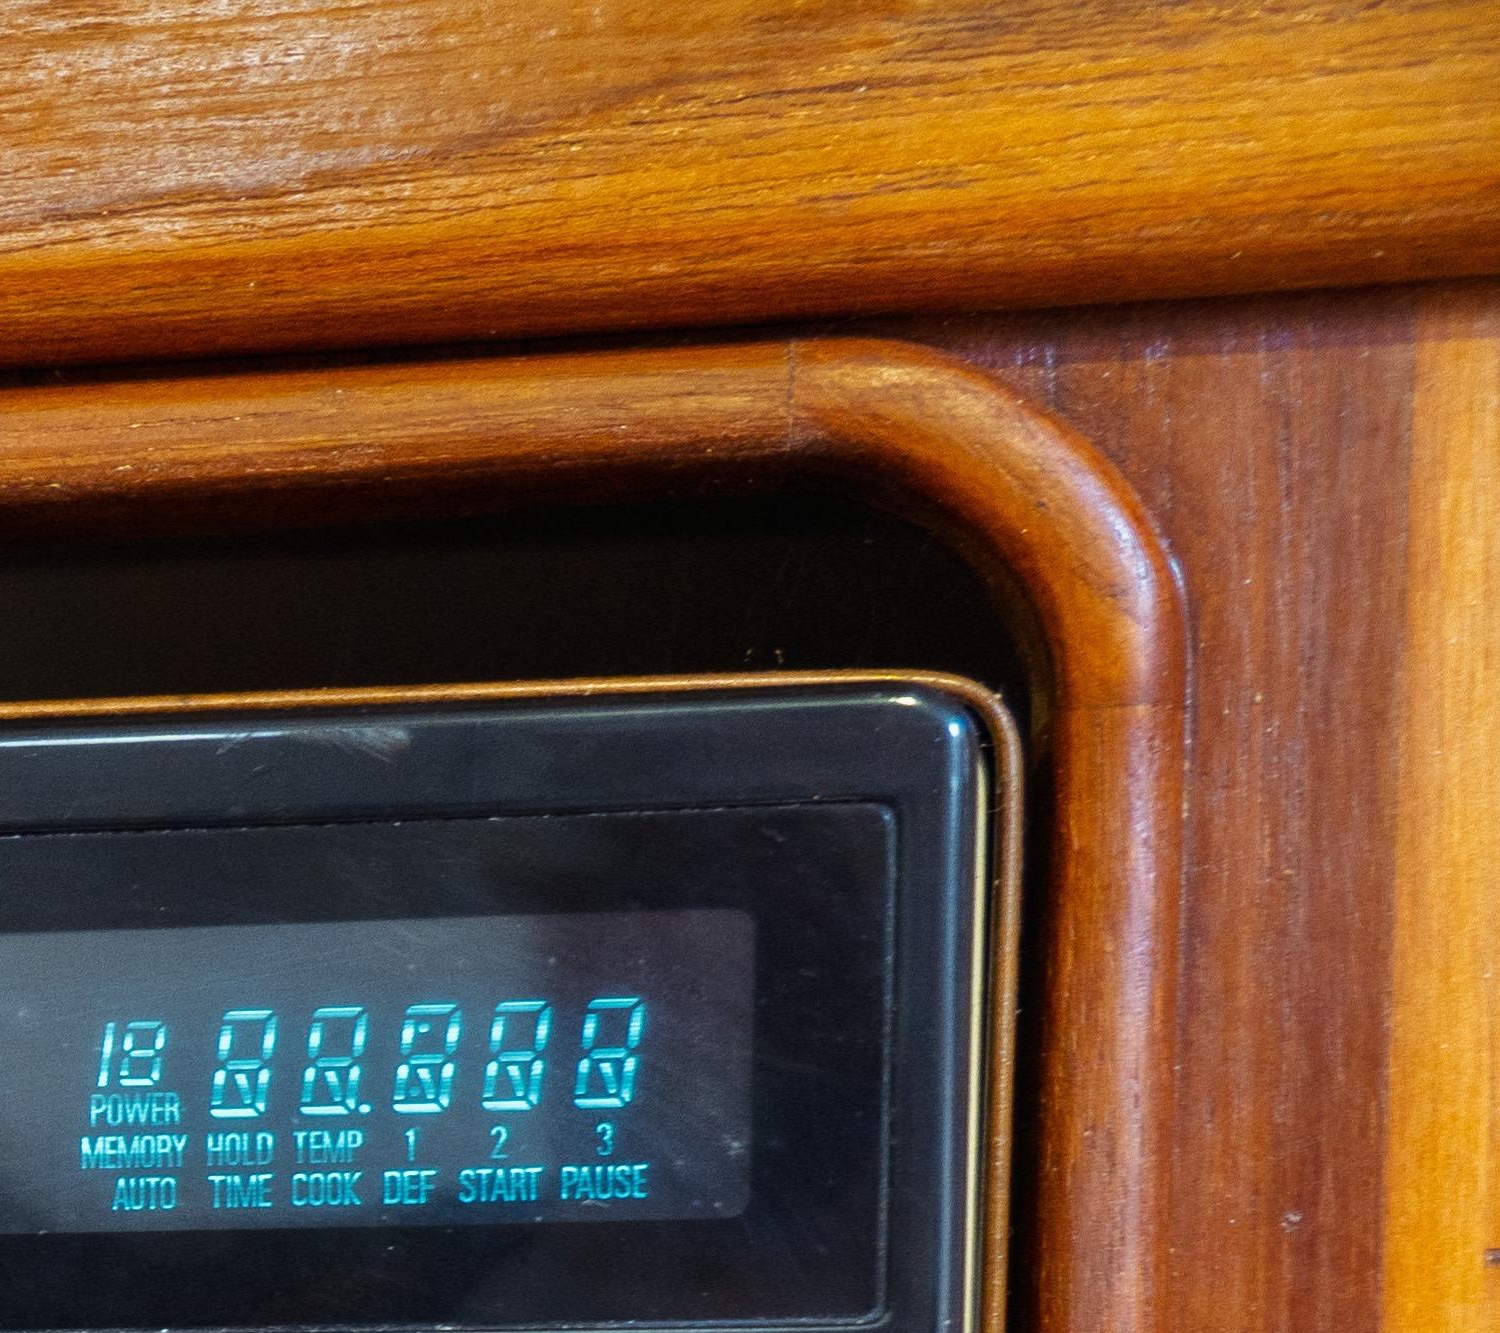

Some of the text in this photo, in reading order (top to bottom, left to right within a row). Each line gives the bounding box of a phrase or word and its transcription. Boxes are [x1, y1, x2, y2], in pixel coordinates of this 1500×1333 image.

[90, 1094, 180, 1126] POWER
[80, 1124, 613, 1169] MEMORY HOLD TEMP 1 2 3
[111, 1163, 649, 1210] AUTO TIME COOK DEF START PAUSE
